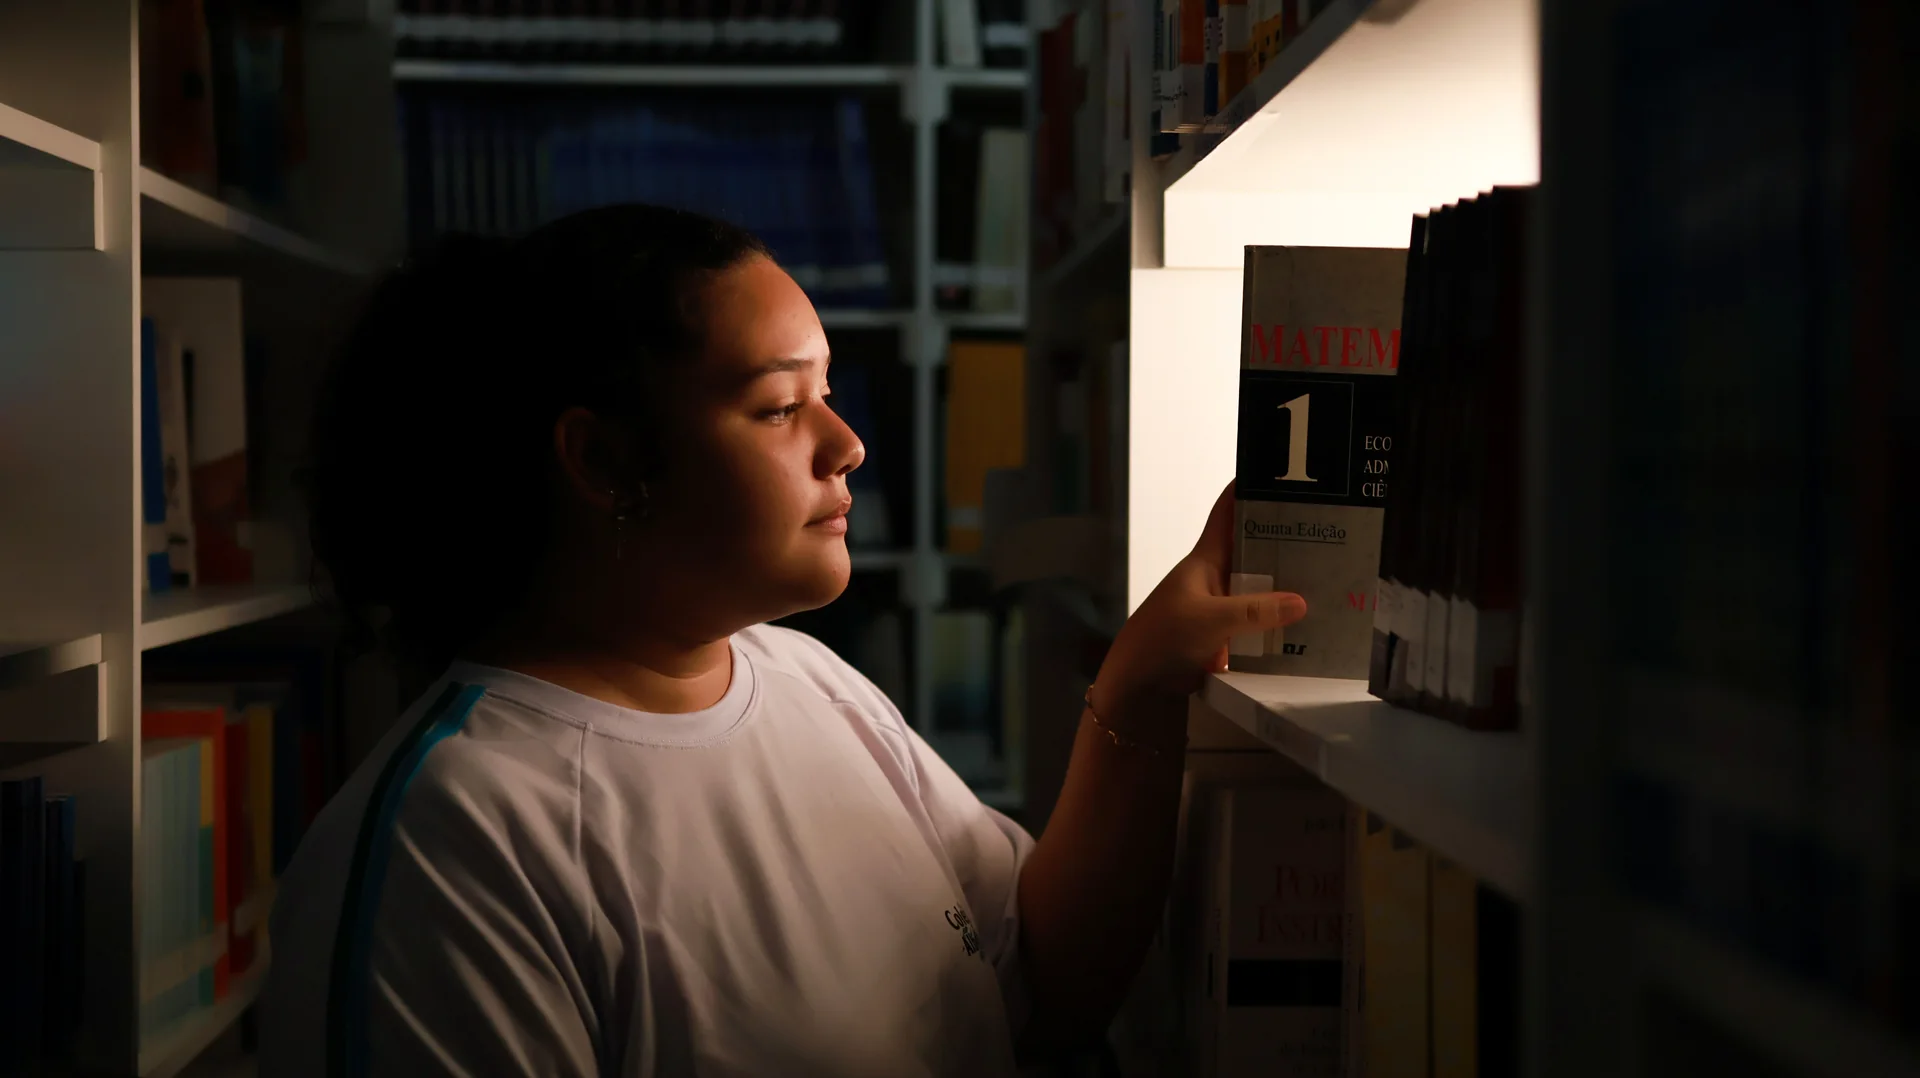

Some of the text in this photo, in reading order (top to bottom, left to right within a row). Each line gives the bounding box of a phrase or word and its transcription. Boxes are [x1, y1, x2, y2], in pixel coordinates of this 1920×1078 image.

[1250, 323, 1401, 369] MATEM
[1274, 393, 1318, 482] 1
[1364, 435, 1392, 451] ECO
[1244, 519, 1346, 540] Quinta Edição
